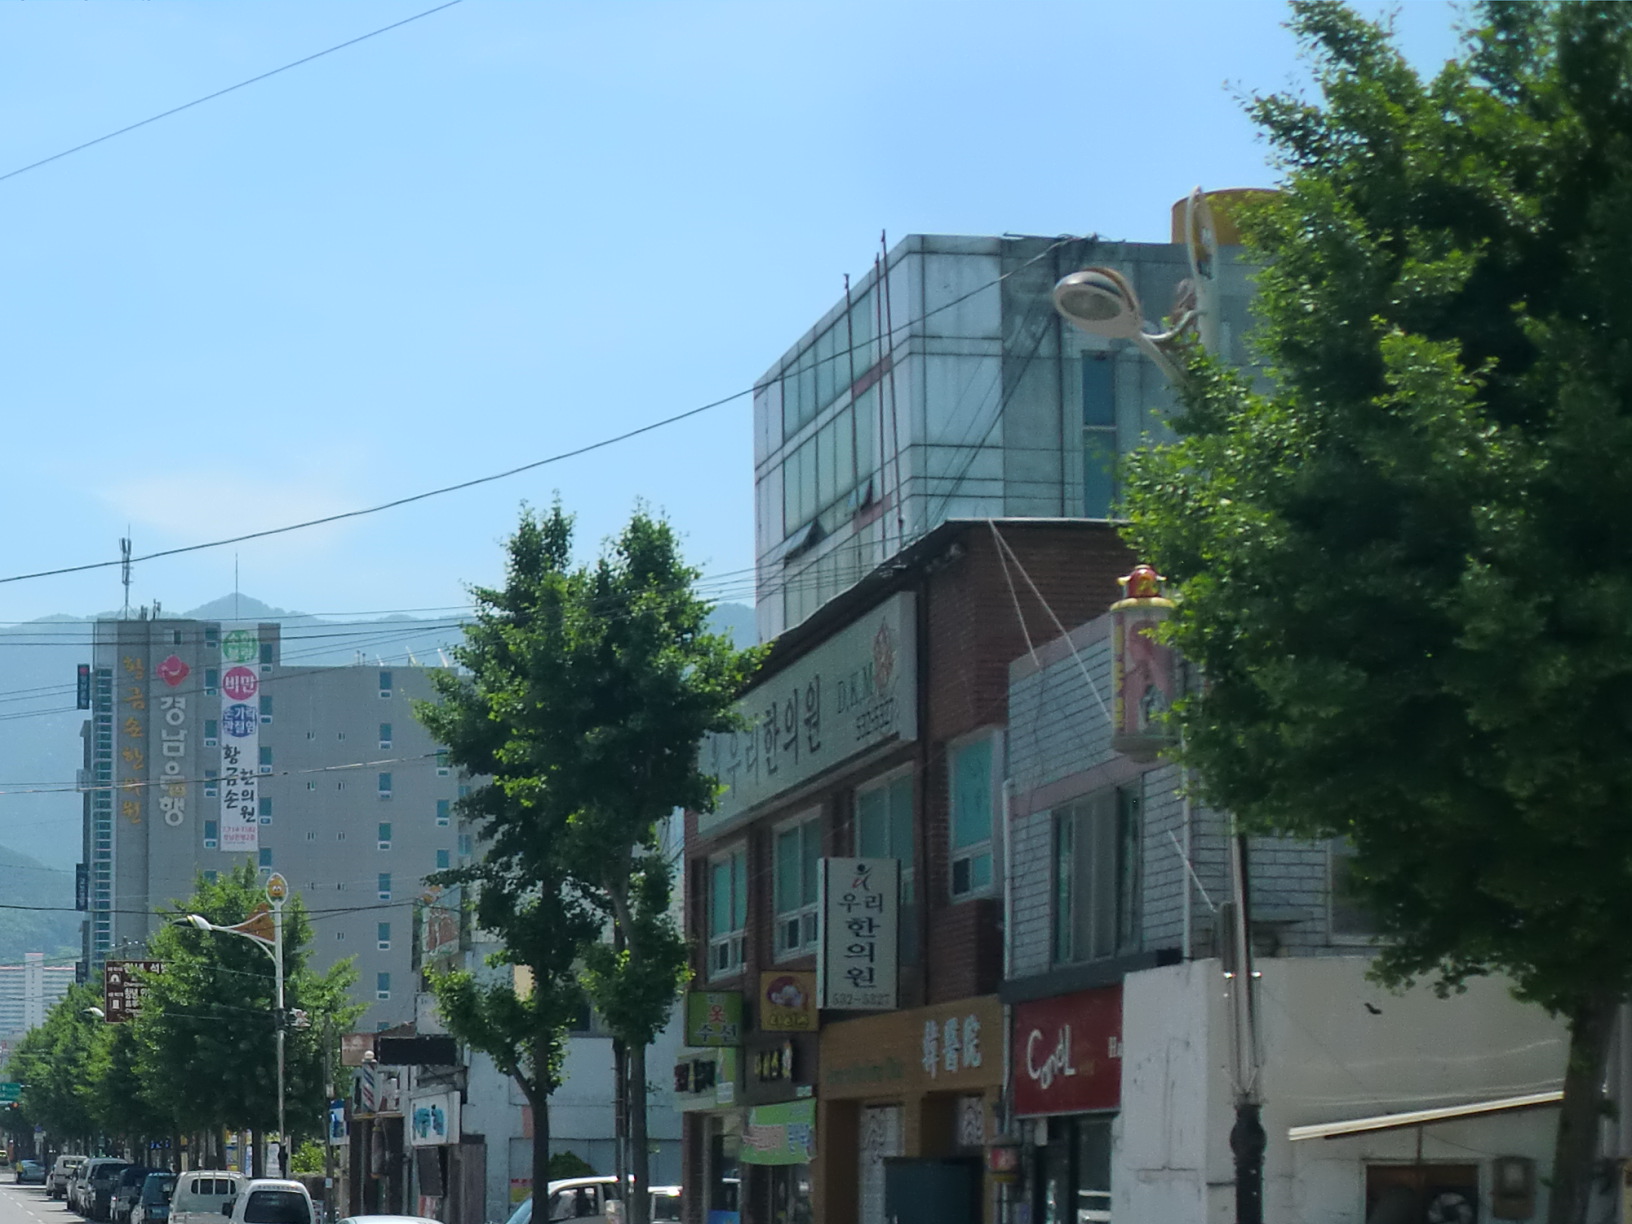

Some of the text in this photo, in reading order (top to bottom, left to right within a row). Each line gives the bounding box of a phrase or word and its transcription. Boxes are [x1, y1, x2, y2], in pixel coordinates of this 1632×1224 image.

[225, 675, 255, 694] 비만
[159, 696, 188, 827] 경남은행
[223, 744, 240, 809] 황금손
[240, 768, 256, 823] 한의원
[838, 893, 883, 913] 우리
[844, 917, 881, 988] 한의원
[709, 1005, 725, 1022] 옷
[696, 1024, 737, 1042] 수선
